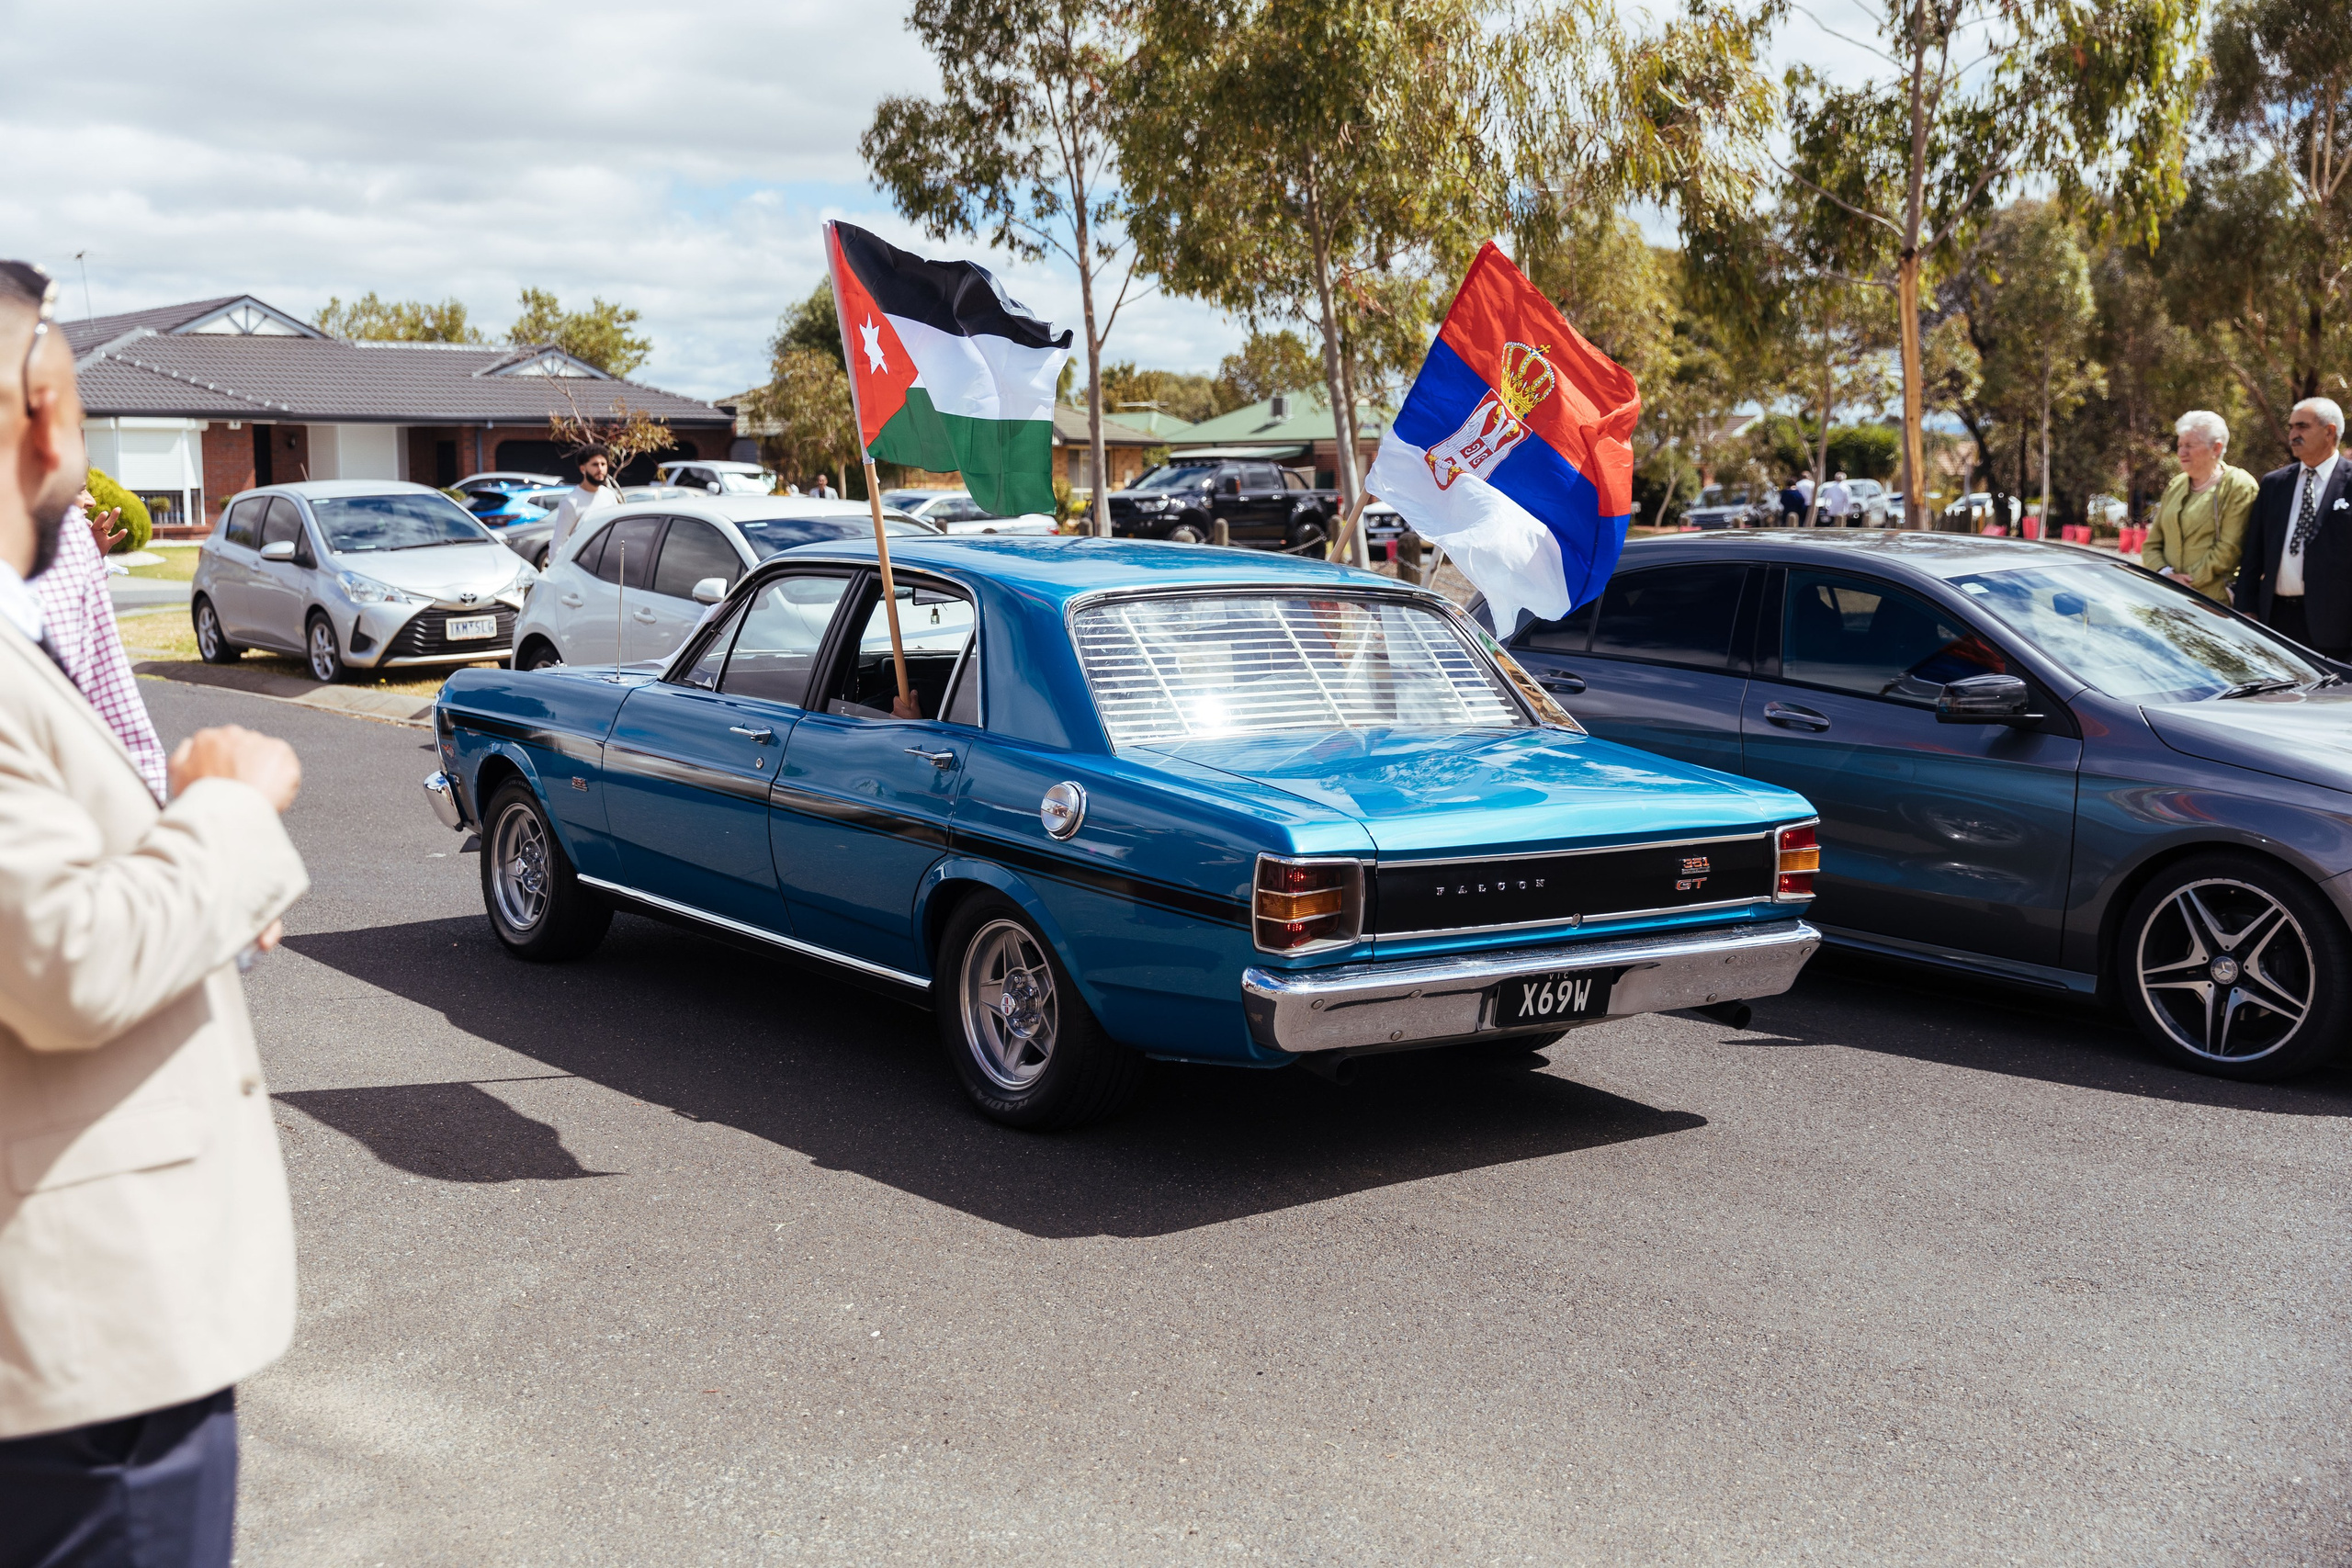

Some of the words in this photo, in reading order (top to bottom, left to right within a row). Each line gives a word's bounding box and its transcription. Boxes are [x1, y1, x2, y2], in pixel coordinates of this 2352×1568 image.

[1682, 856, 1710, 869] 351
[1436, 879, 1545, 896] FALCON
[1676, 876, 1708, 891] GT
[1549, 972, 1569, 980] VIC
[1518, 978, 1592, 1017] X69W
